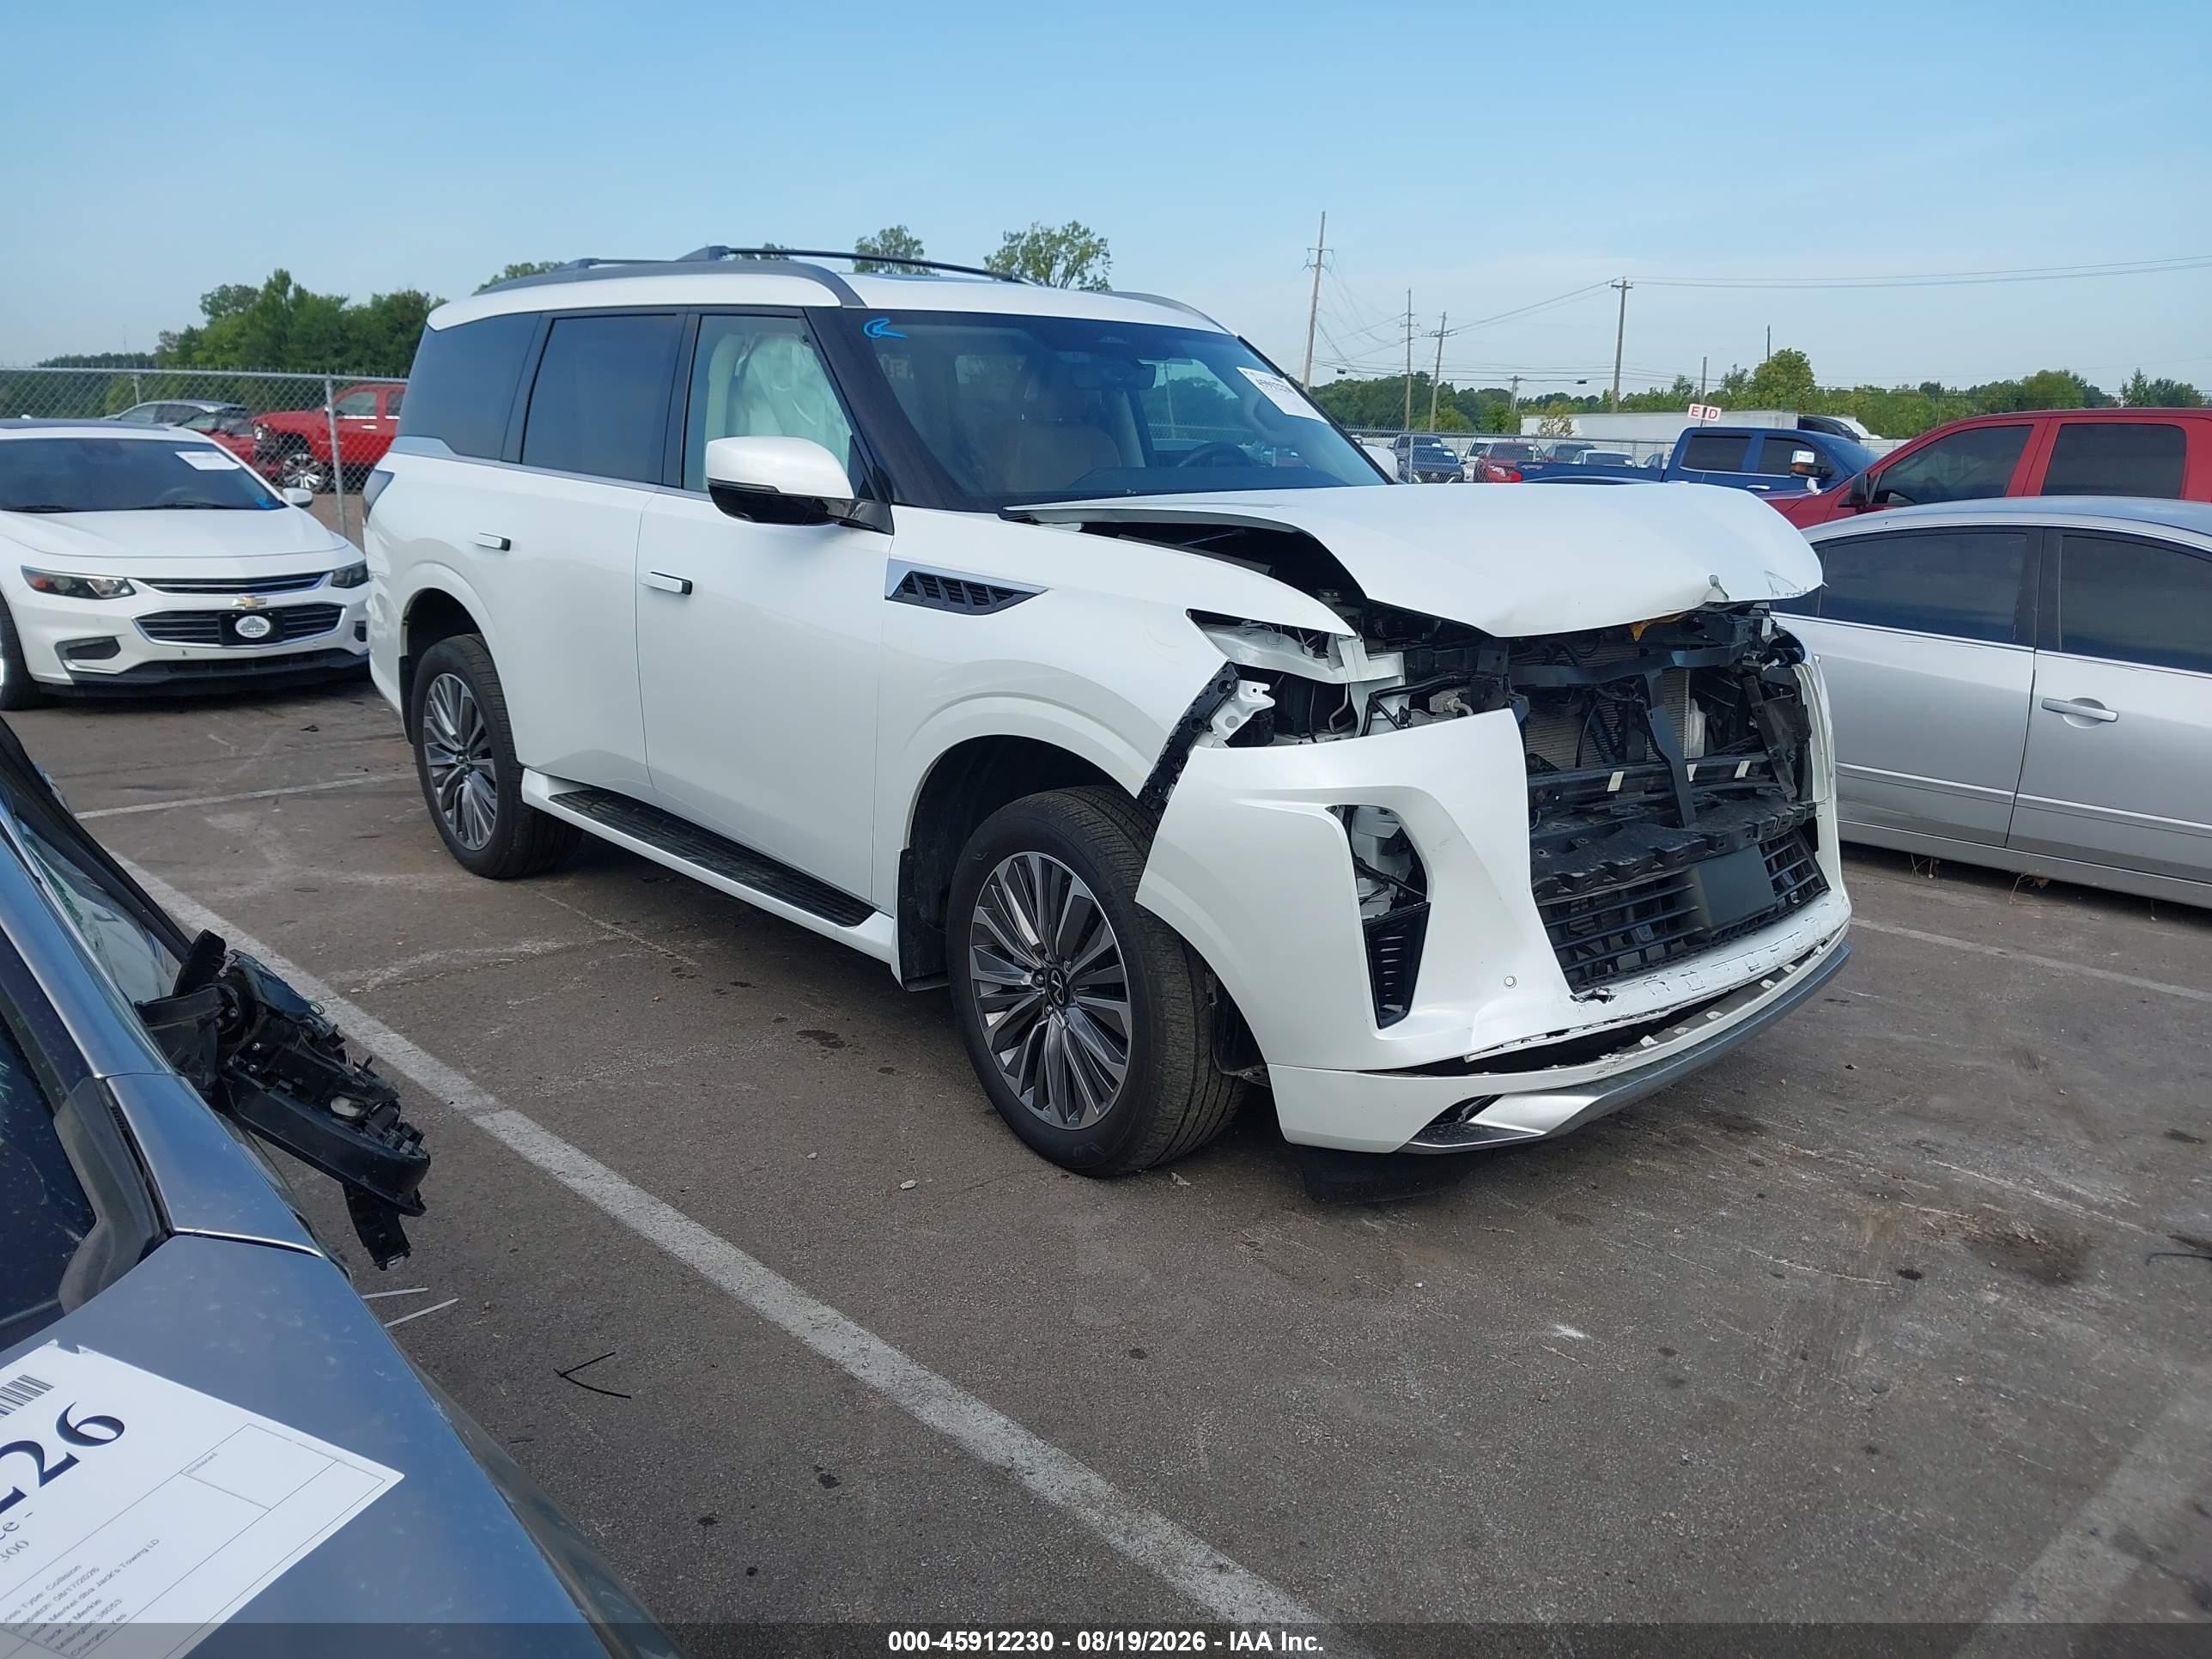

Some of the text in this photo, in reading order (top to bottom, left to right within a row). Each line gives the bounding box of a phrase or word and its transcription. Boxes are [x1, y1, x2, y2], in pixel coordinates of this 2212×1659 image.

[46, 1565, 82, 1591] Collision
[52, 1566, 100, 1601] 08/17/2026
[78, 1587, 96, 1600] dba
[118, 1547, 149, 1569] Towing
[44, 1628, 63, 1645] Jack
[54, 1619, 96, 1650] Millington
